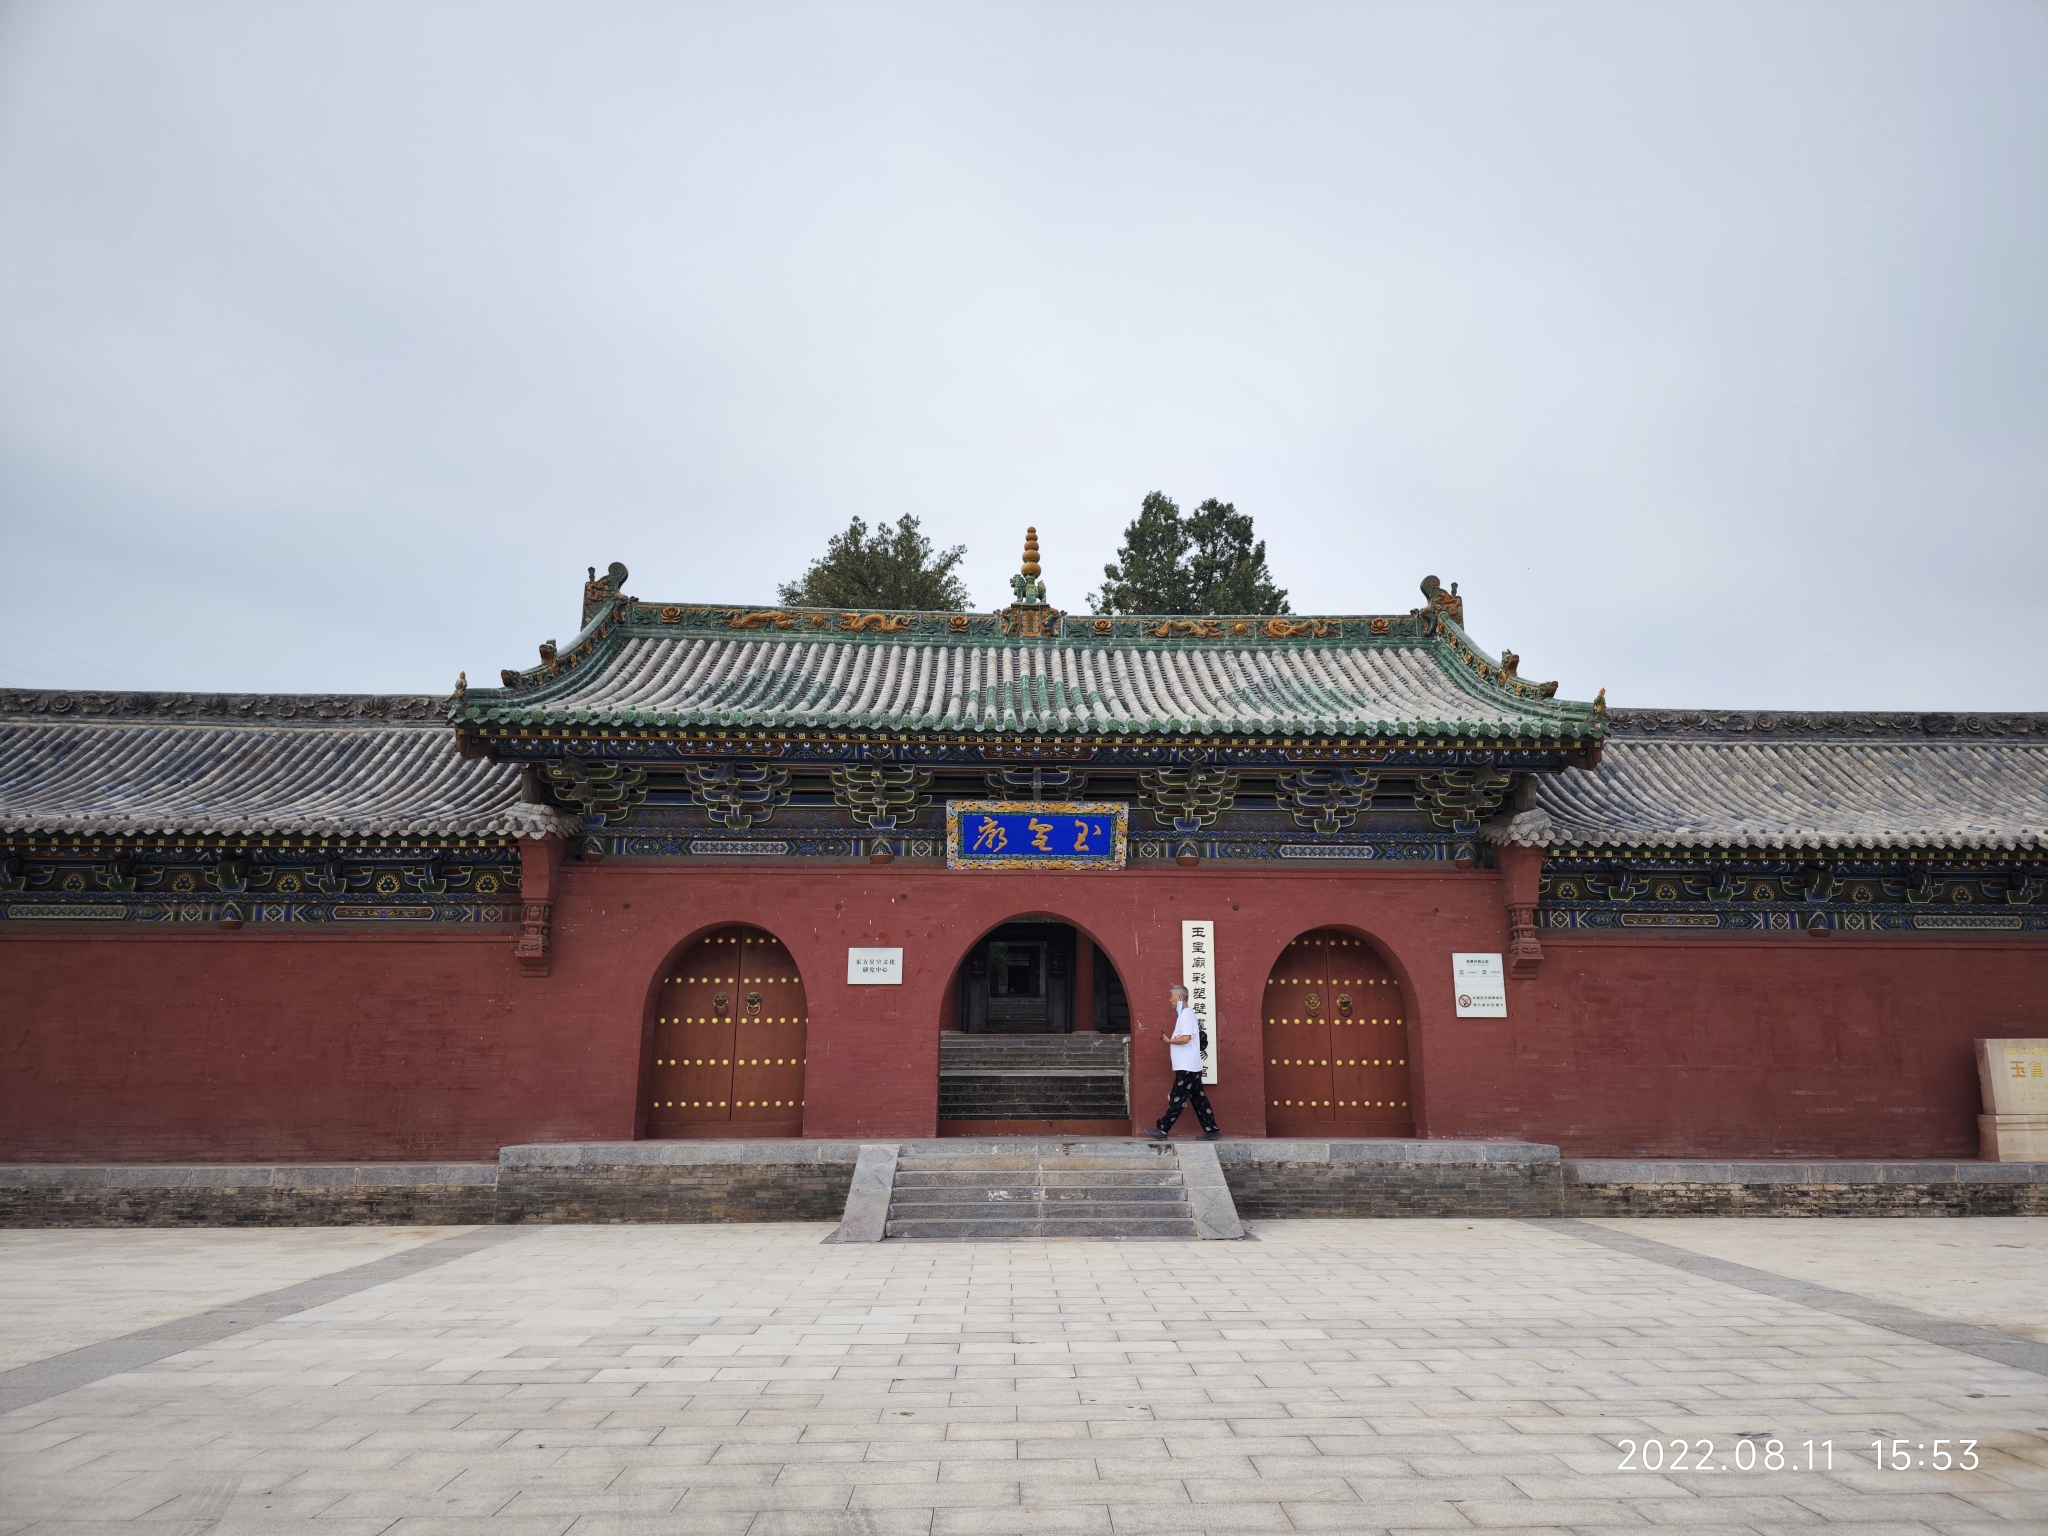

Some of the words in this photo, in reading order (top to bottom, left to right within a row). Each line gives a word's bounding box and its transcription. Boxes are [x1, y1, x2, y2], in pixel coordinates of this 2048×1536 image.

[1191, 926, 1209, 1078] 玉皇廟彩塑壁畫物
